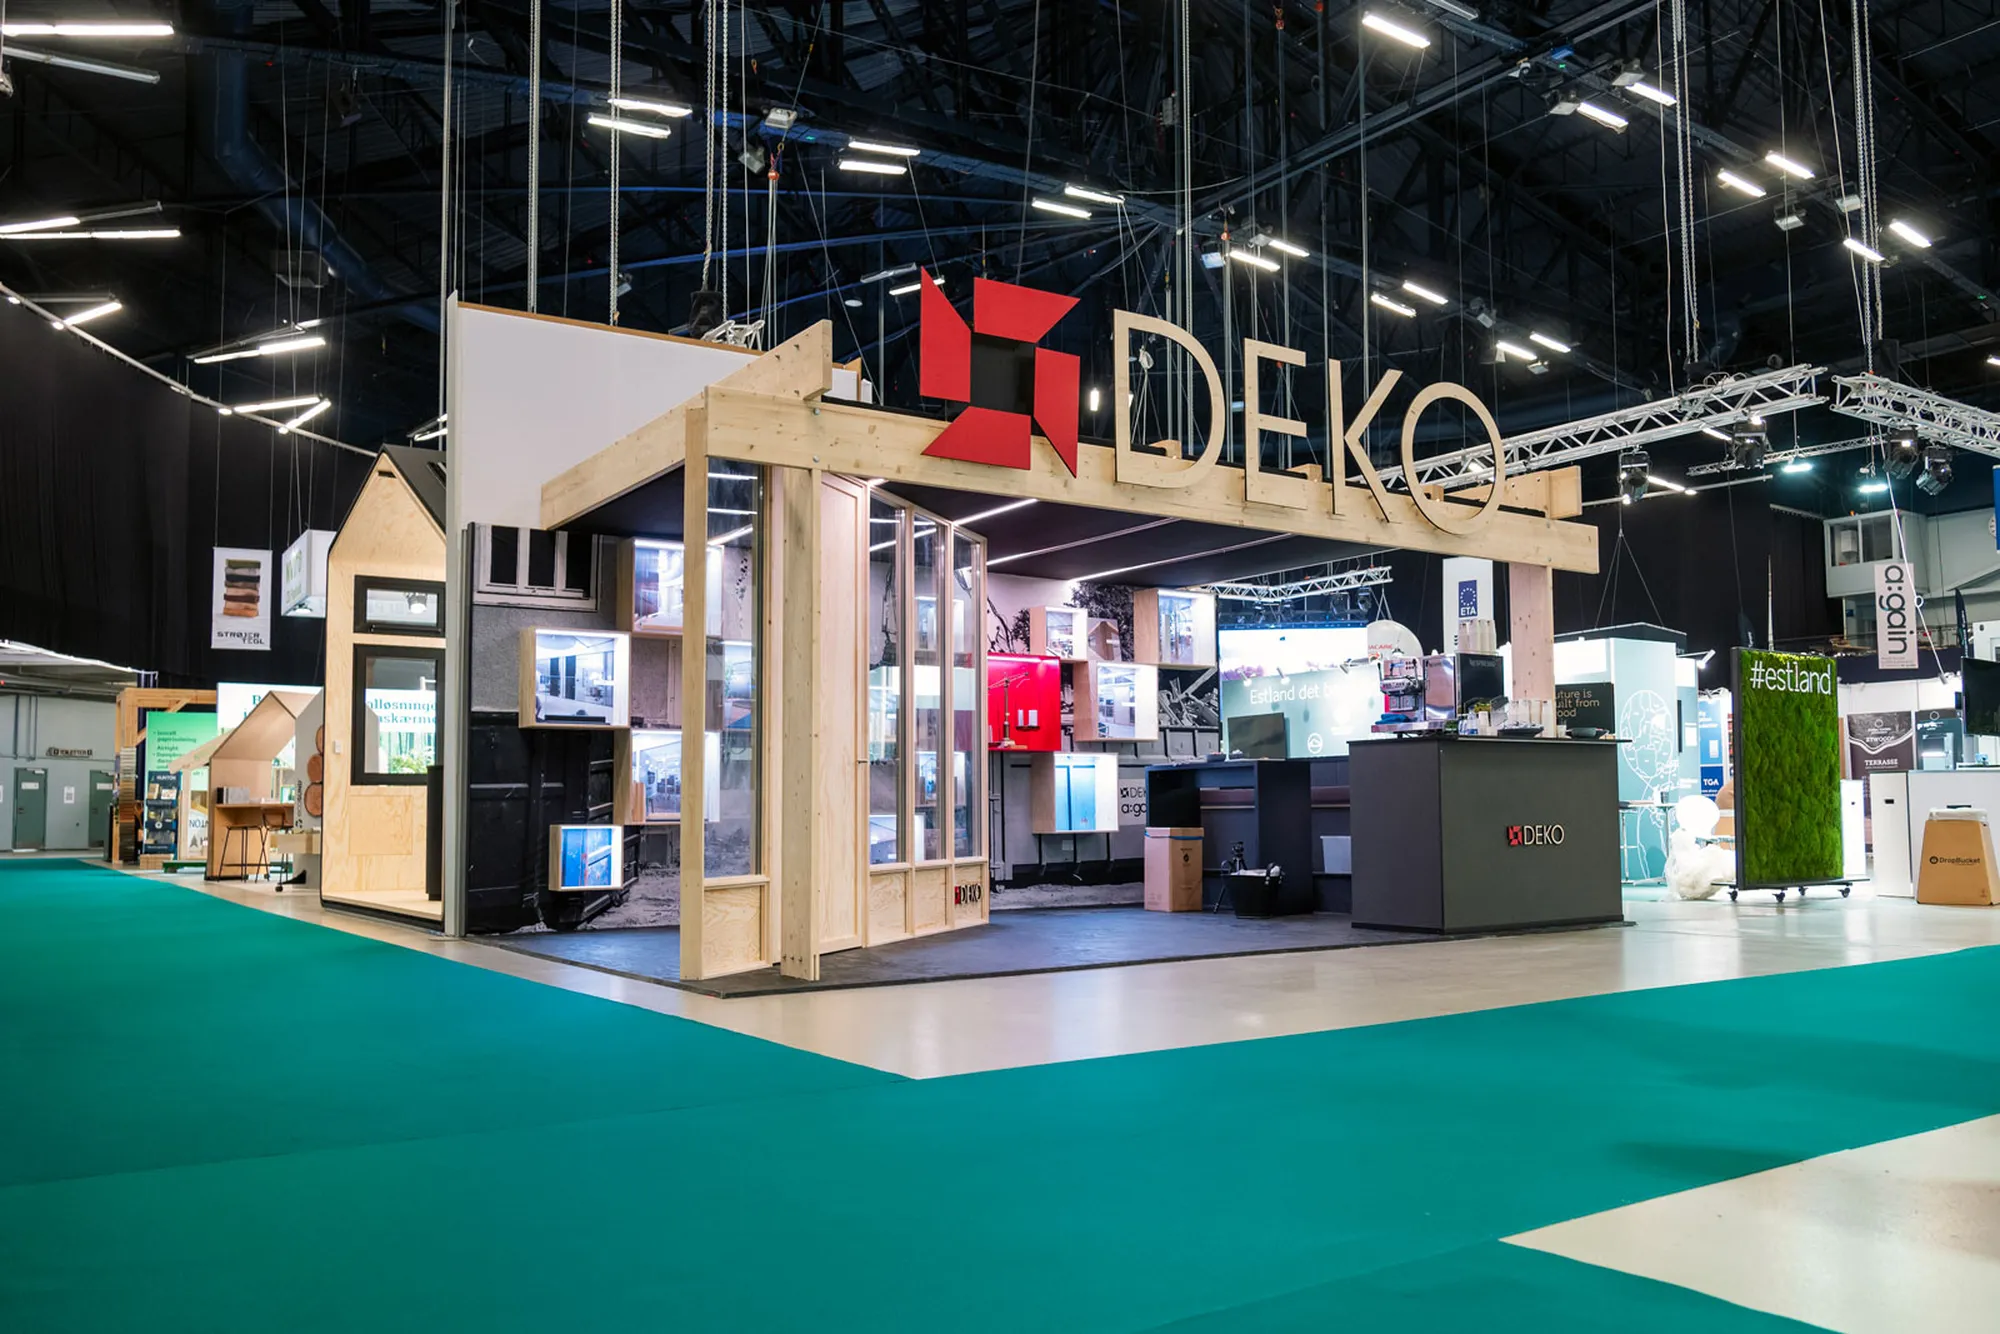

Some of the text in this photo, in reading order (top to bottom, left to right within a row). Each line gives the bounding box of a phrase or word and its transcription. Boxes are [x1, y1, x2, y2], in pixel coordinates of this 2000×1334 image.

[1113, 308, 1502, 535] DEKO
[1460, 606, 1476, 616] ETA
[1879, 565, 1914, 655] a:gain
[1749, 660, 1832, 695] #estland
[1250, 685, 1295, 704] Estland
[1298, 683, 1320, 700] det
[1576, 698, 1600, 708] from
[1583, 688, 1592, 699] is
[1523, 824, 1565, 845] DEKO
[1939, 856, 1981, 864] DropBucket
